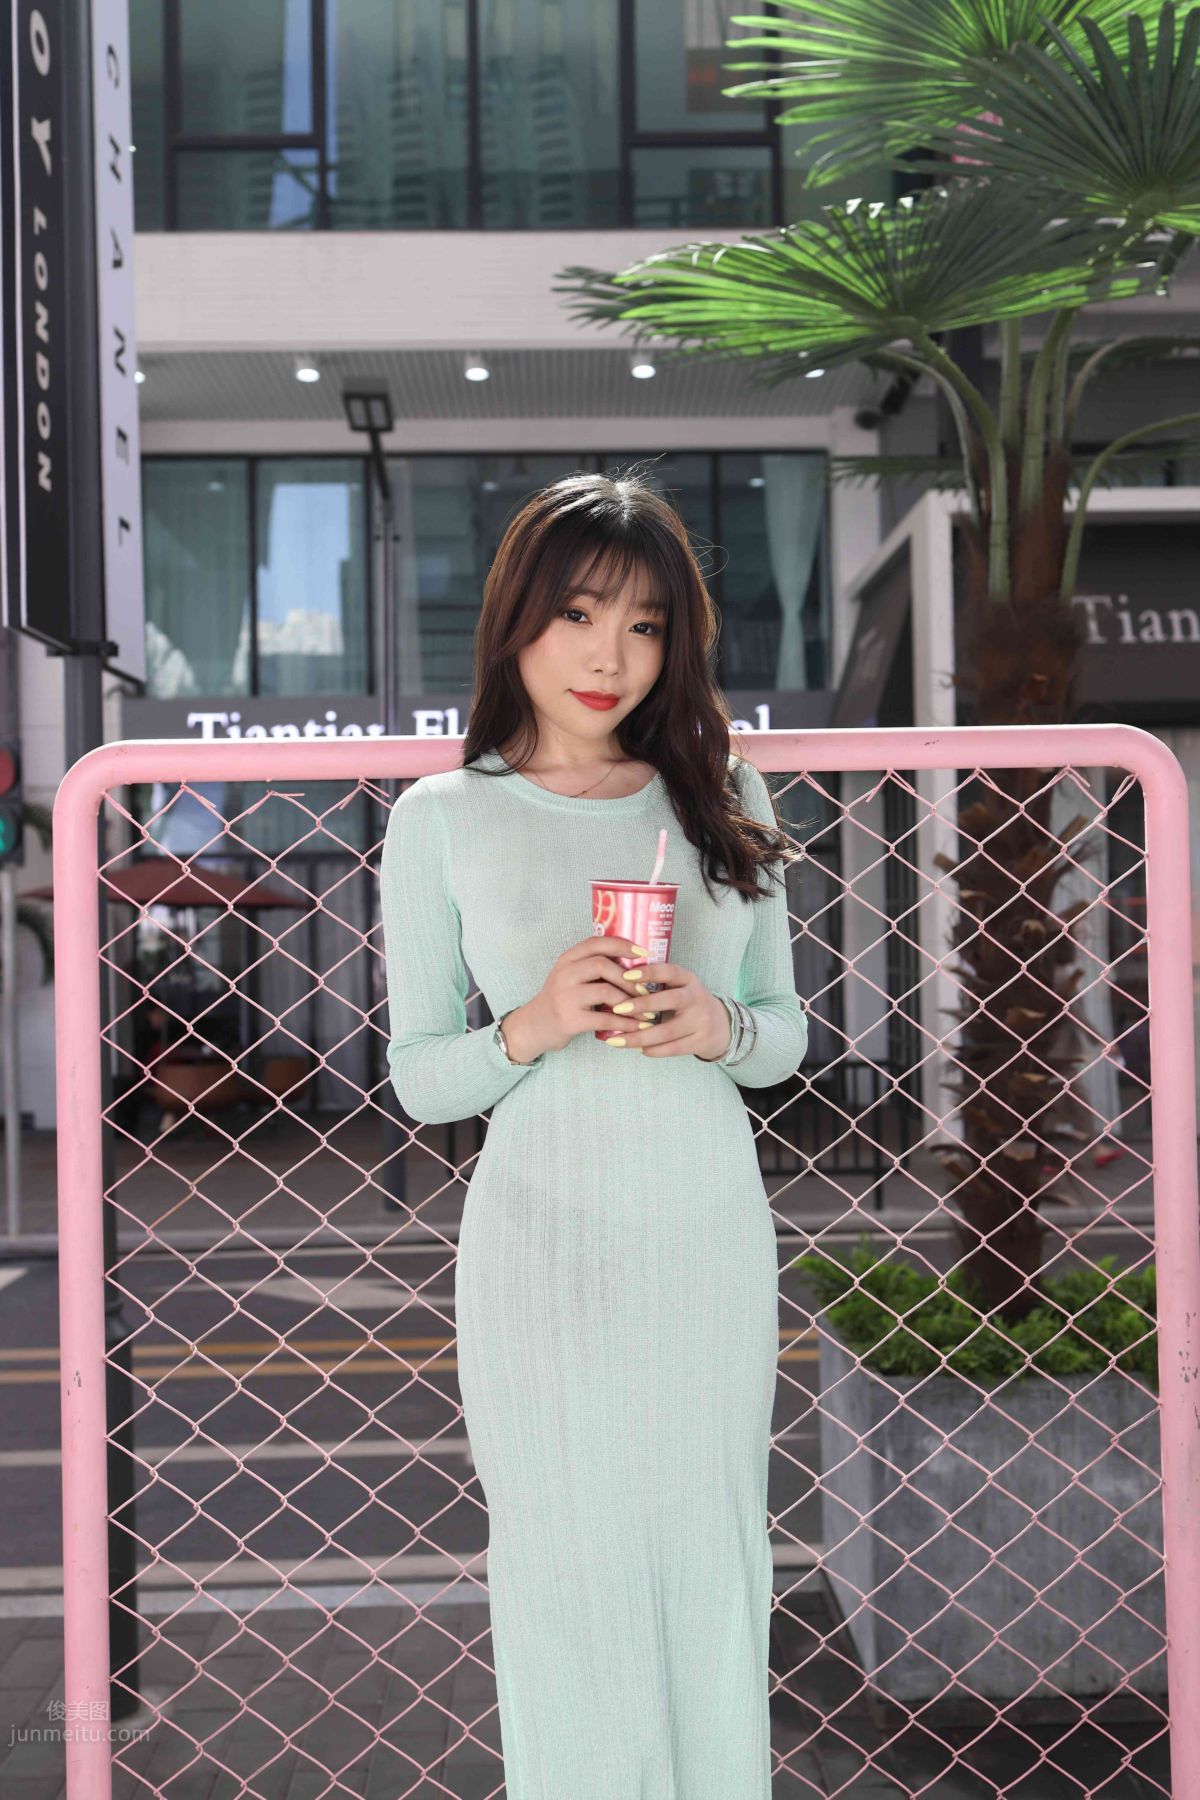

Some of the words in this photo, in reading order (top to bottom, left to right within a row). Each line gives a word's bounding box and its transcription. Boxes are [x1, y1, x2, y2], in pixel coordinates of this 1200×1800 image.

[34, 206, 52, 492] LONDON
[106, 43, 131, 547] CHANEL
[1070, 594, 1200, 644] Tian
